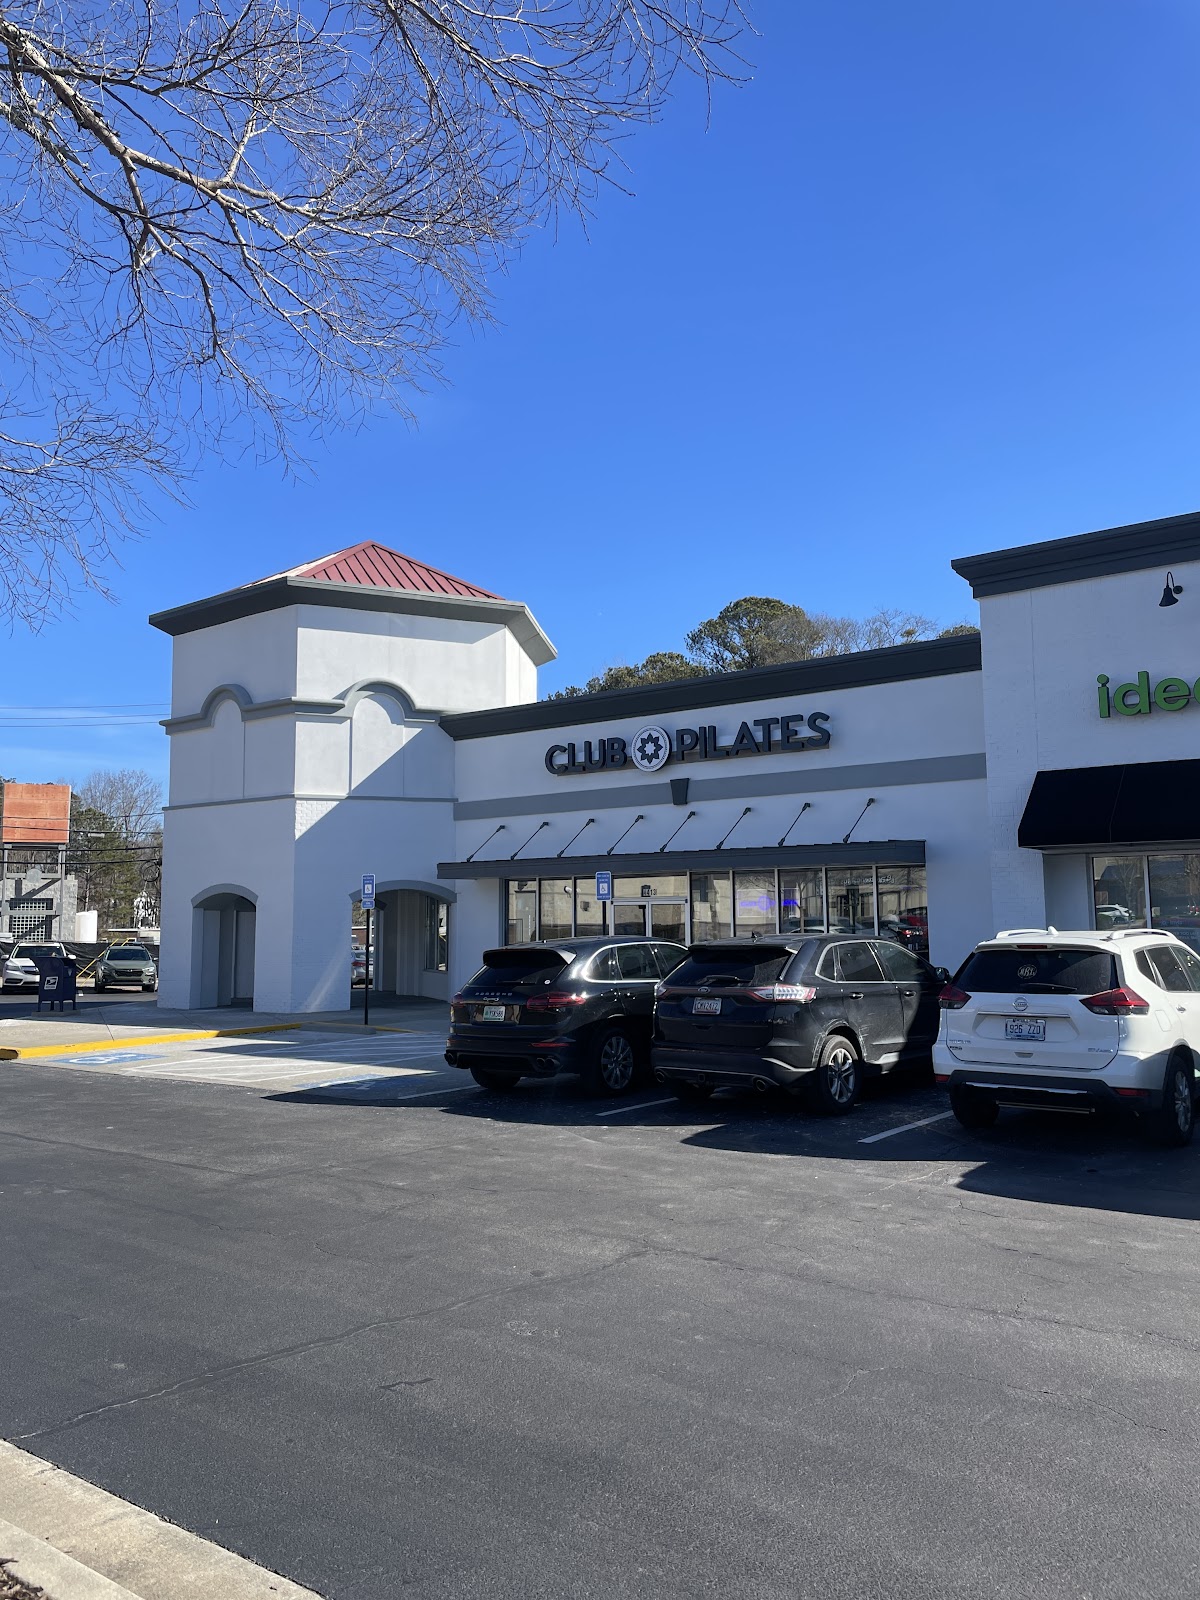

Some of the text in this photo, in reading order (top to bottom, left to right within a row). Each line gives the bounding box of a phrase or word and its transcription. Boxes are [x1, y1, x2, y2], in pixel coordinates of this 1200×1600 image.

[1097, 671, 1200, 718] ide
[545, 712, 831, 775] CLUB PILATES
[1010, 1025, 1022, 1034] 926
